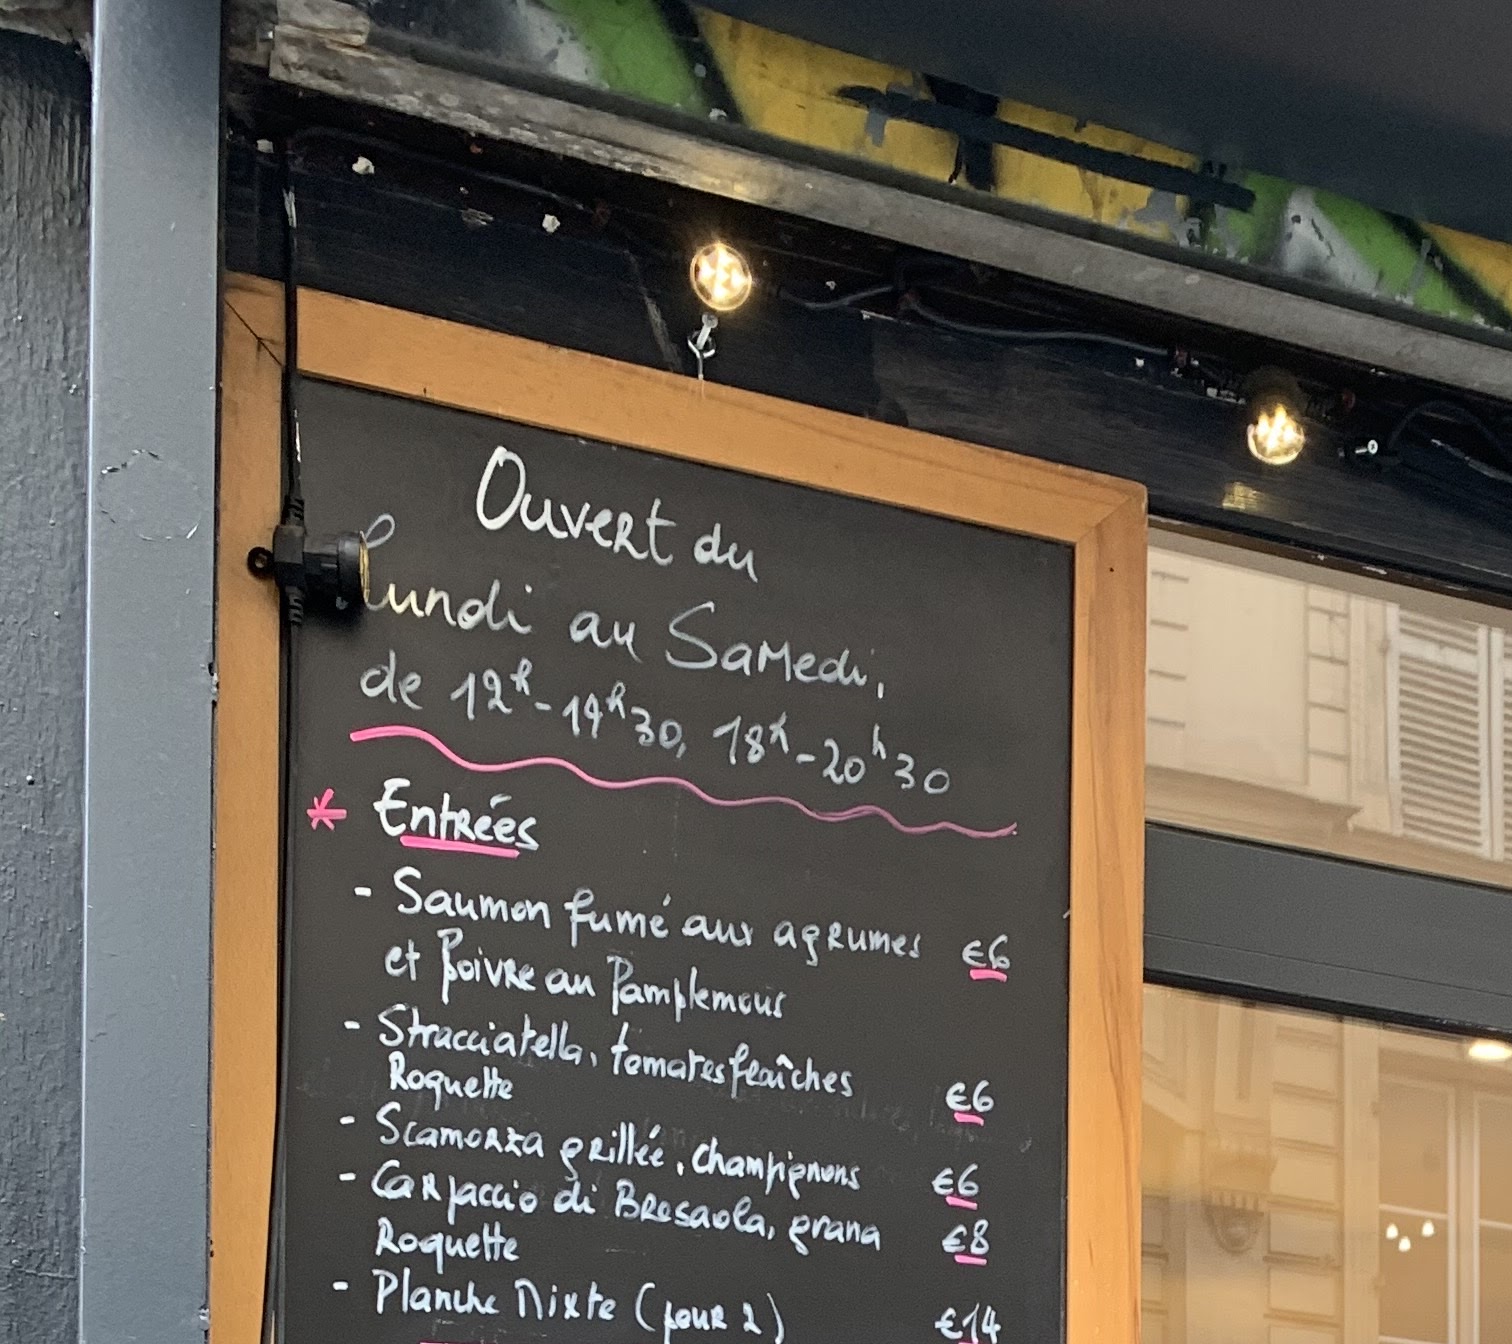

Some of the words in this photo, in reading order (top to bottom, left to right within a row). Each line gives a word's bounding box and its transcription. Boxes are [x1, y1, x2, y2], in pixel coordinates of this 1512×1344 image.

[475, 445, 676, 566] Ouvert
[693, 522, 758, 583] du
[569, 611, 638, 660] au
[360, 649, 422, 710] de
[372, 777, 540, 857] Entrées
[393, 865, 551, 929] Saumon
[563, 888, 671, 948] fumé
[681, 914, 753, 947] aux
[773, 921, 921, 967] agrumes
[961, 934, 1011, 970] €6
[384, 939, 421, 981] et
[544, 968, 596, 997] au
[388, 1050, 514, 1112] Roquette
[945, 1079, 994, 1113] €6
[375, 1100, 545, 1158] Scamorza
[931, 1163, 979, 1204] €6
[370, 1159, 538, 1226] Carpaccio
[553, 1180, 598, 1215] di
[788, 1214, 881, 1256] grana
[941, 1218, 990, 1255] €8
[375, 1216, 520, 1275] Roquette
[371, 1266, 500, 1315] Planche
